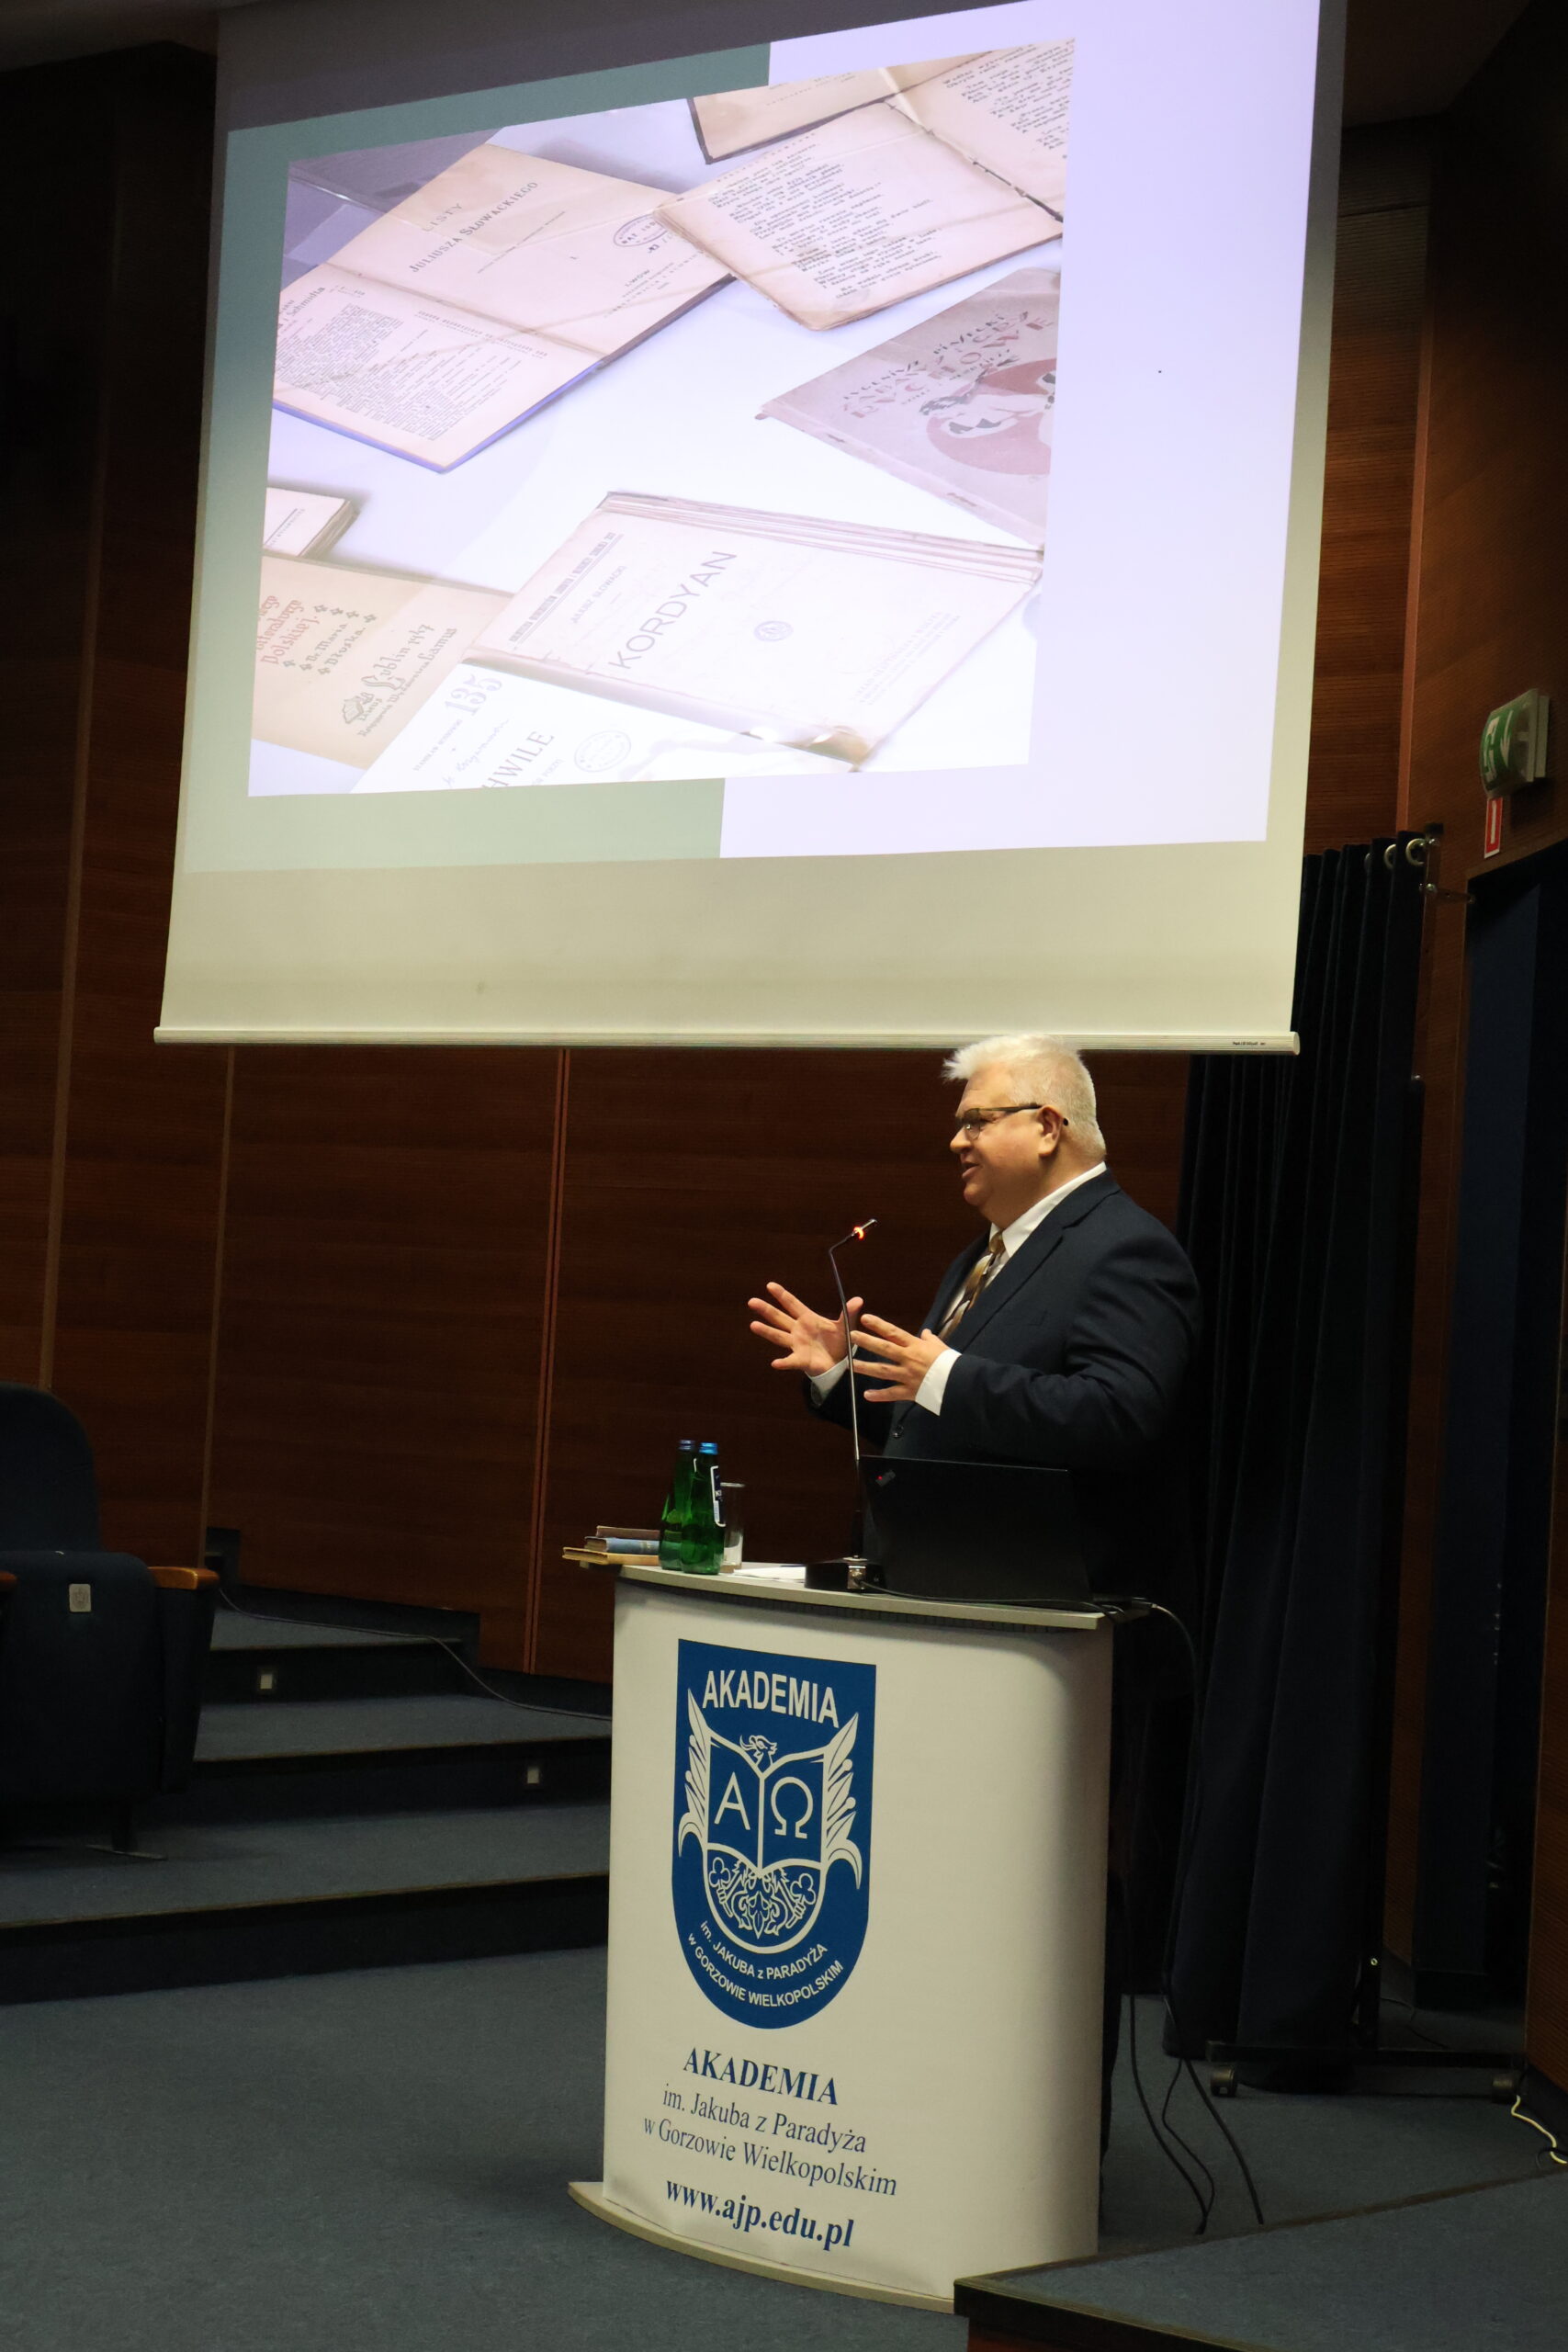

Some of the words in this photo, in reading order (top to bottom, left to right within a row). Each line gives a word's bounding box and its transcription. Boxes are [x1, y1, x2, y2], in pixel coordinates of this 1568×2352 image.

[409, 237, 463, 274] JULIUSZA
[459, 181, 538, 238] SŁOWACKIEGO
[420, 202, 463, 233] LISTY
[608, 549, 738, 671] KORDYAN
[702, 1669, 840, 1728] AKADEMIA
[770, 1776, 814, 1839] Ω
[694, 1944, 747, 2002] GORZOWIE
[748, 1960, 844, 2007] WIELKOPOLSKIM
[700, 1919, 714, 1943] im.
[712, 1940, 755, 1976] JAKUBA
[757, 1969, 764, 1980] z
[766, 1942, 829, 1980] PARADYŻA
[682, 2046, 839, 2106] AKADEMIA
[662, 2082, 685, 2111] im.
[691, 2093, 750, 2129] Jakuba
[755, 2115, 767, 2132] z
[772, 2112, 866, 2154] Paradyża
[644, 2117, 655, 2135] w
[659, 2118, 736, 2161] Gorzowie
[743, 2141, 897, 2196] Wielkopolskim
[666, 2179, 855, 2251] www.ajp.edu.pl
